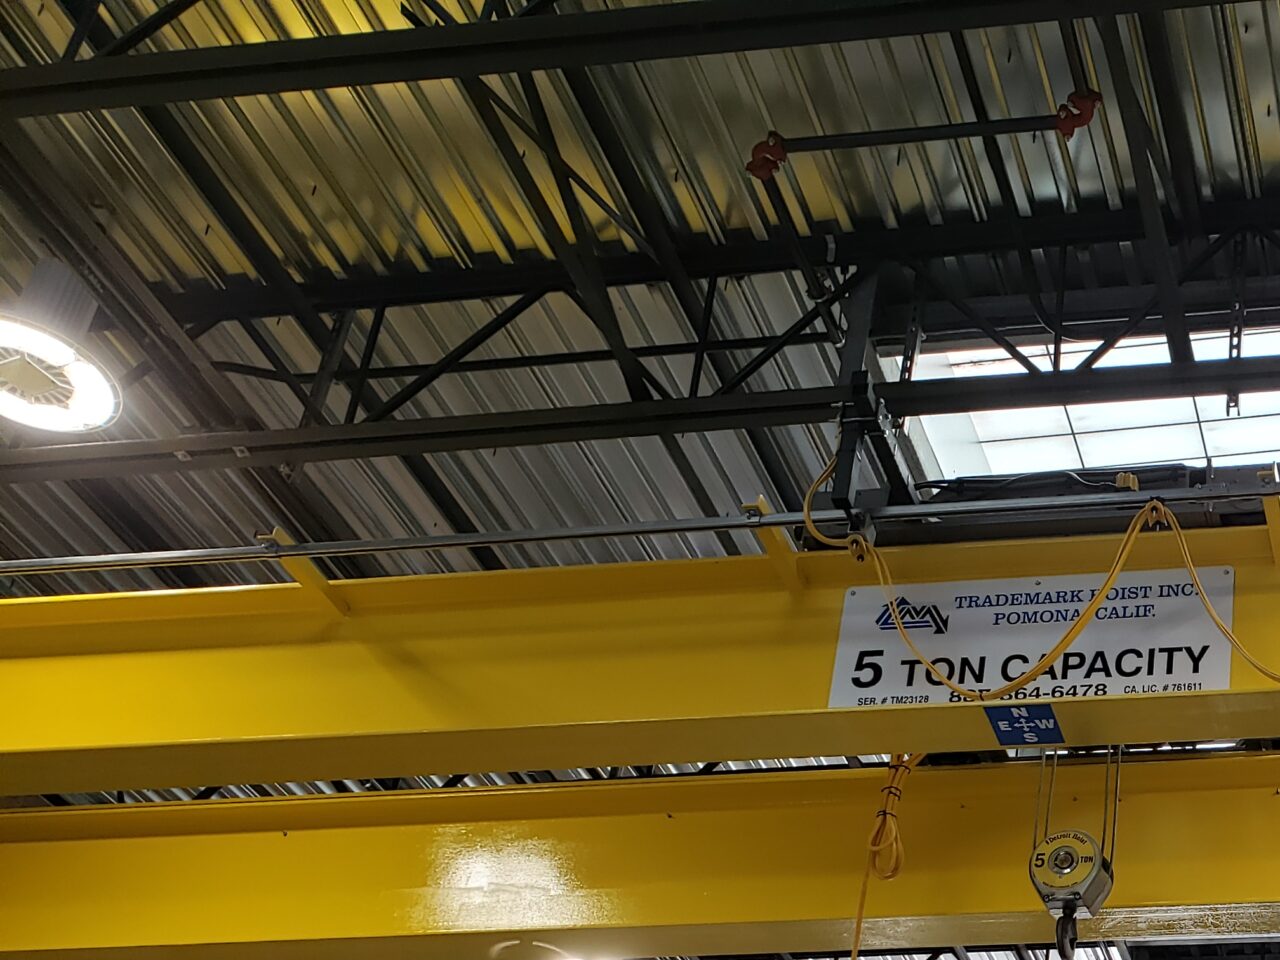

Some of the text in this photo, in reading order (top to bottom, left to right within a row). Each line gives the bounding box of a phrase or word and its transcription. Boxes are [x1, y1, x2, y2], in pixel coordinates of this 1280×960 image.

[955, 589, 1084, 609] TRADEMARK
[1157, 583, 1199, 598] INC.
[1094, 604, 1156, 620] CALIF.
[851, 645, 1211, 689] 5 TON CAPACITY
[1123, 682, 1202, 694] CA. LIC. # 761611
[857, 695, 930, 706] SER. # TM23128
[1011, 707, 1029, 718] N
[999, 718, 1055, 731] E W
[1024, 732, 1039, 743] S
[1034, 853, 1046, 868] 5
